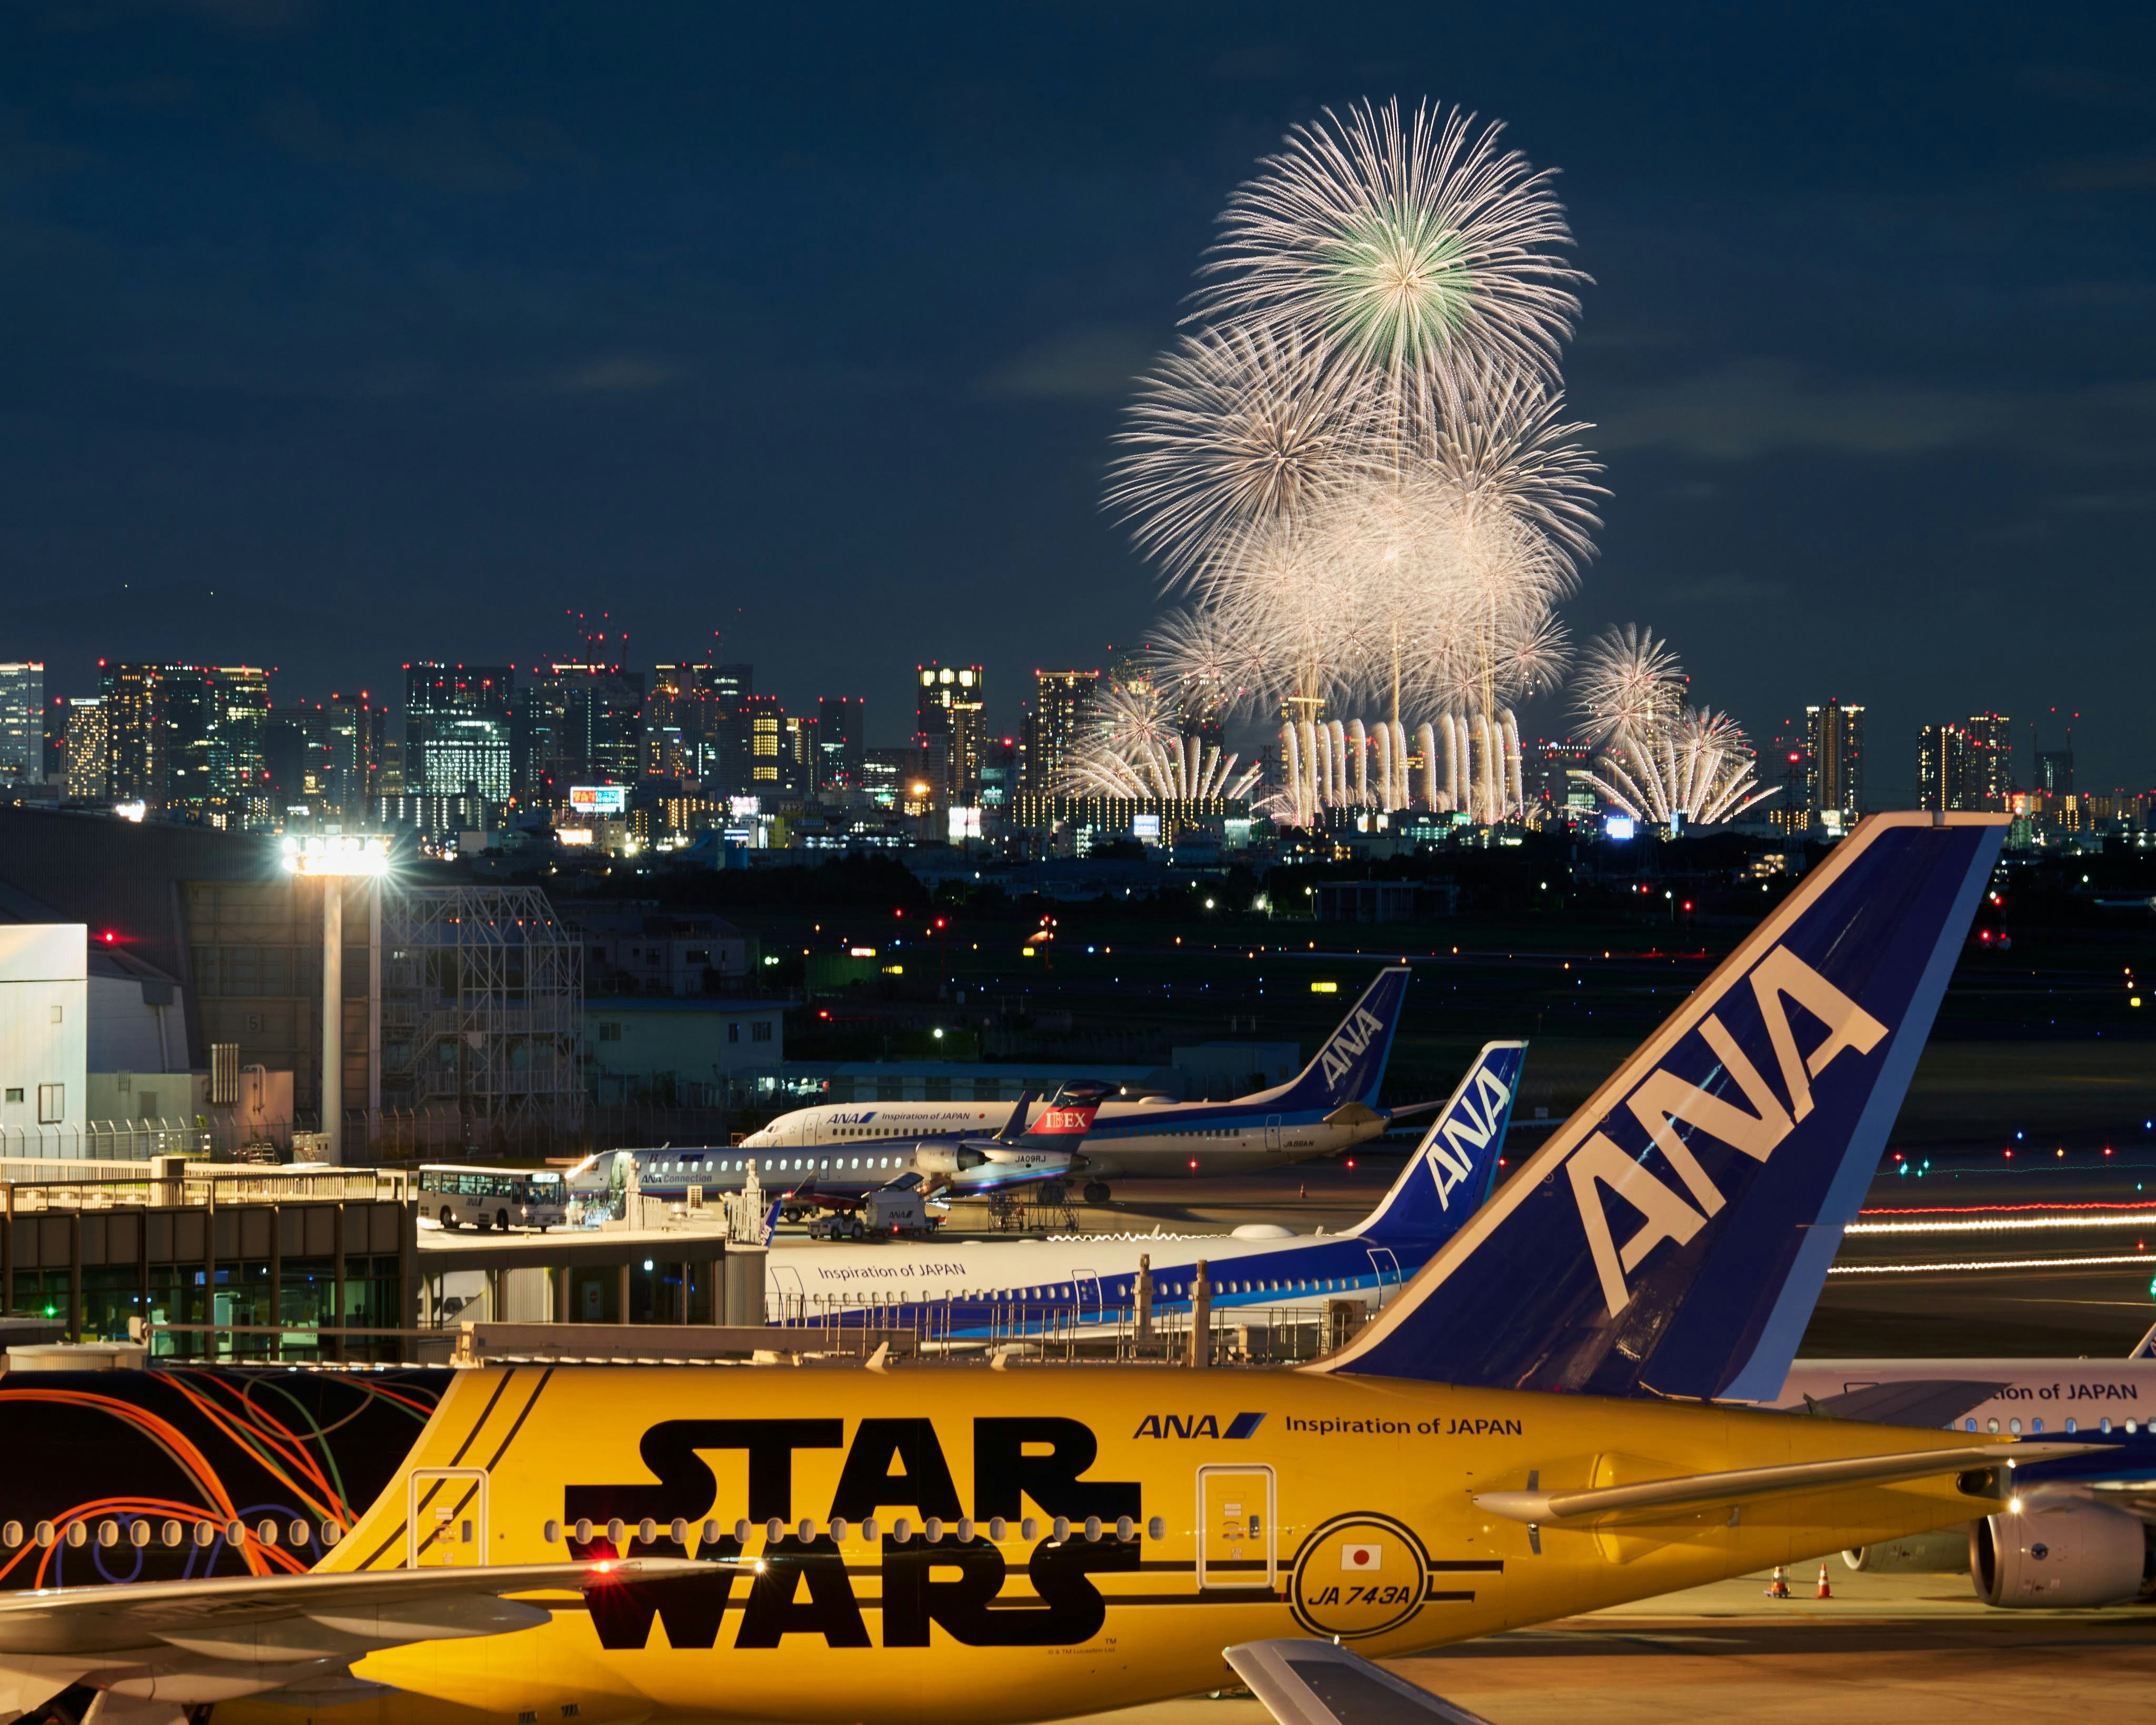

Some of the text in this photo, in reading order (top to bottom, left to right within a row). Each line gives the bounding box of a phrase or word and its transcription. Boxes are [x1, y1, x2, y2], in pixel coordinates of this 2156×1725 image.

[249, 1016, 258, 1031] 5
[1321, 1006, 1384, 1091] ANA
[826, 1113, 860, 1124] ANA
[882, 1112, 927, 1123] Inspiration
[1045, 1111, 1086, 1128] IBEX
[1425, 1065, 1511, 1212] ANA
[1565, 944, 1890, 1319] ANA
[641, 1174, 712, 1183] ANA Connection
[817, 1263, 966, 1281] Inspiration of JAPAN
[2038, 1383, 2060, 1400] of
[2067, 1383, 2138, 1400] JAPAN
[1132, 1414, 1522, 1439] ANA Inspiration of JAPAN
[564, 1417, 1142, 1527] STAR
[565, 1532, 1142, 1650] WARS
